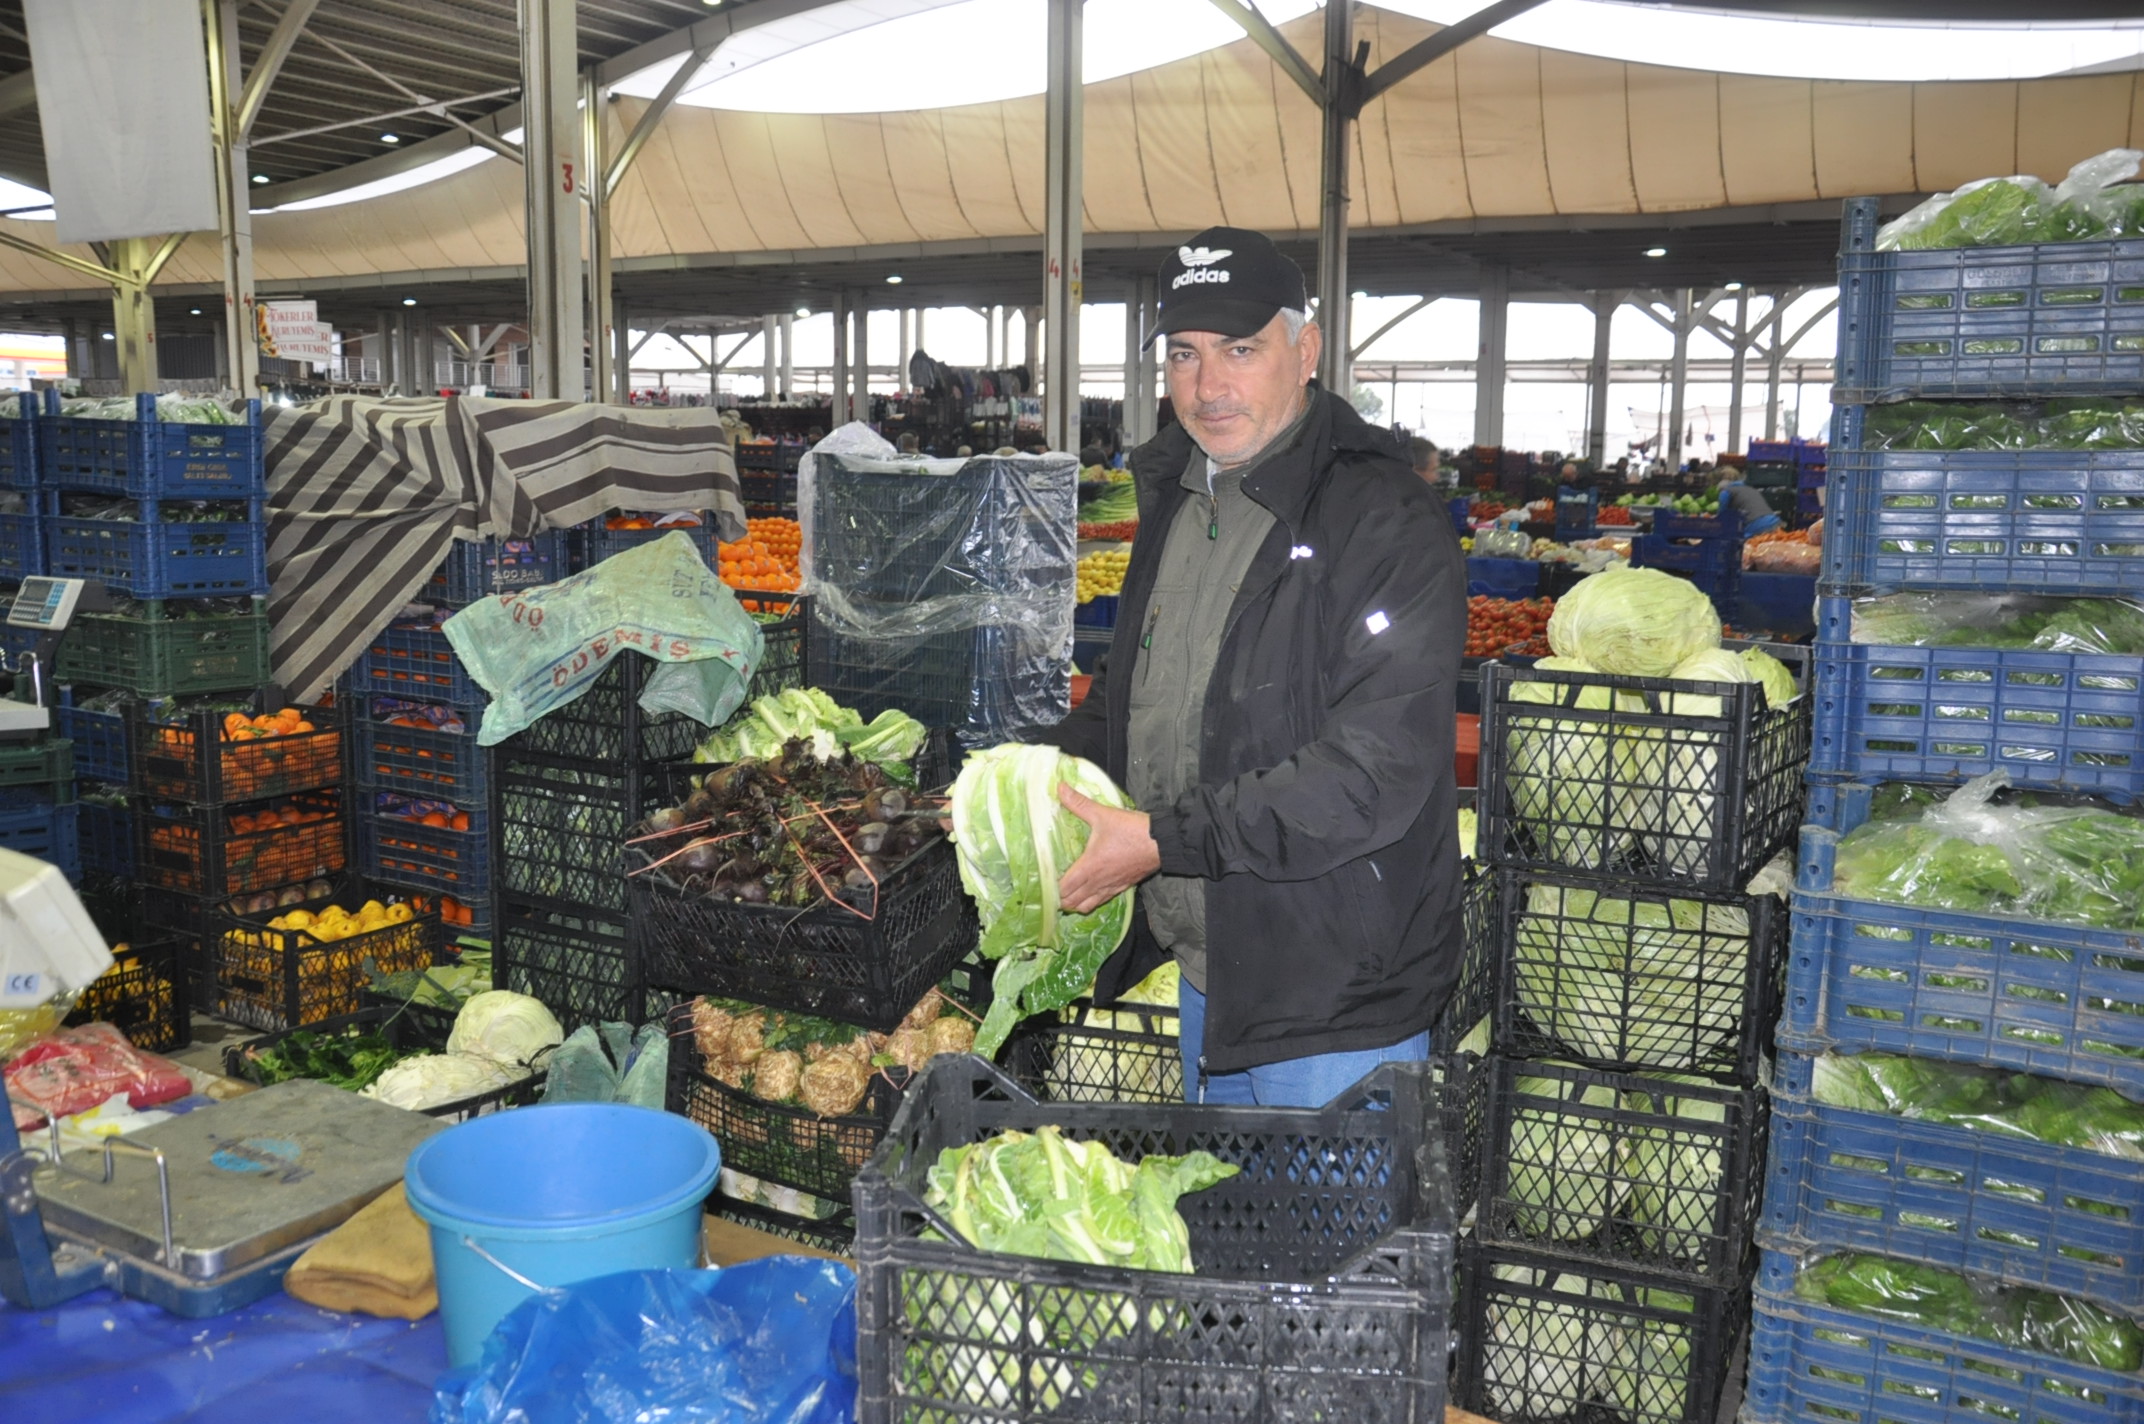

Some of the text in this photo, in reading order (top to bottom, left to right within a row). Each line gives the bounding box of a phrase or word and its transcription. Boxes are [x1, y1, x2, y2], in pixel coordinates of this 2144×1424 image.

[562, 163, 573, 194] 3
[1172, 267, 1230, 290] adidas
[147, 333, 154, 344] 5
[605, 325, 612, 337] 5
[11, 974, 34, 991] CE
